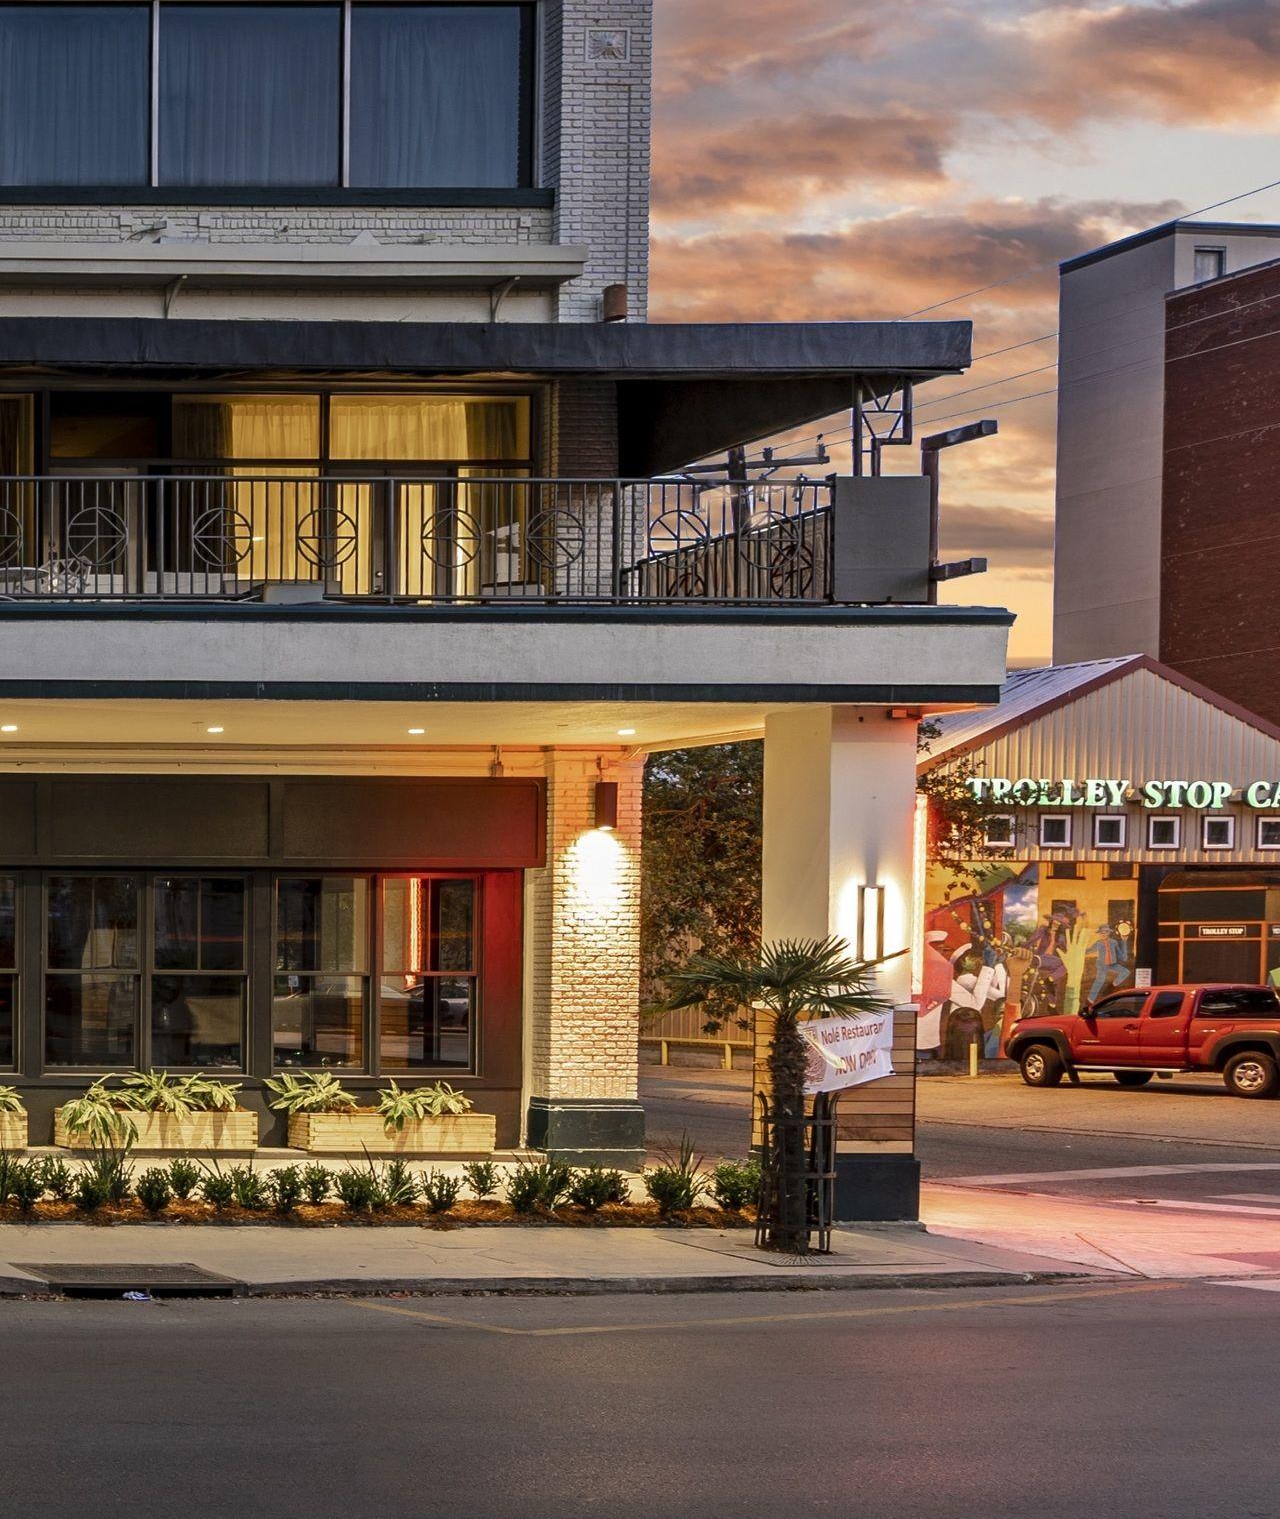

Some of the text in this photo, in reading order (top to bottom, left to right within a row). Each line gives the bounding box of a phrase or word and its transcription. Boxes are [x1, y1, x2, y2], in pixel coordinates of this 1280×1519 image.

[967, 777, 1130, 807] TROLLEY
[1144, 780, 1233, 809] STOP
[1201, 927, 1244, 935] TROLLEY STOP
[821, 1027, 840, 1045] Nolé
